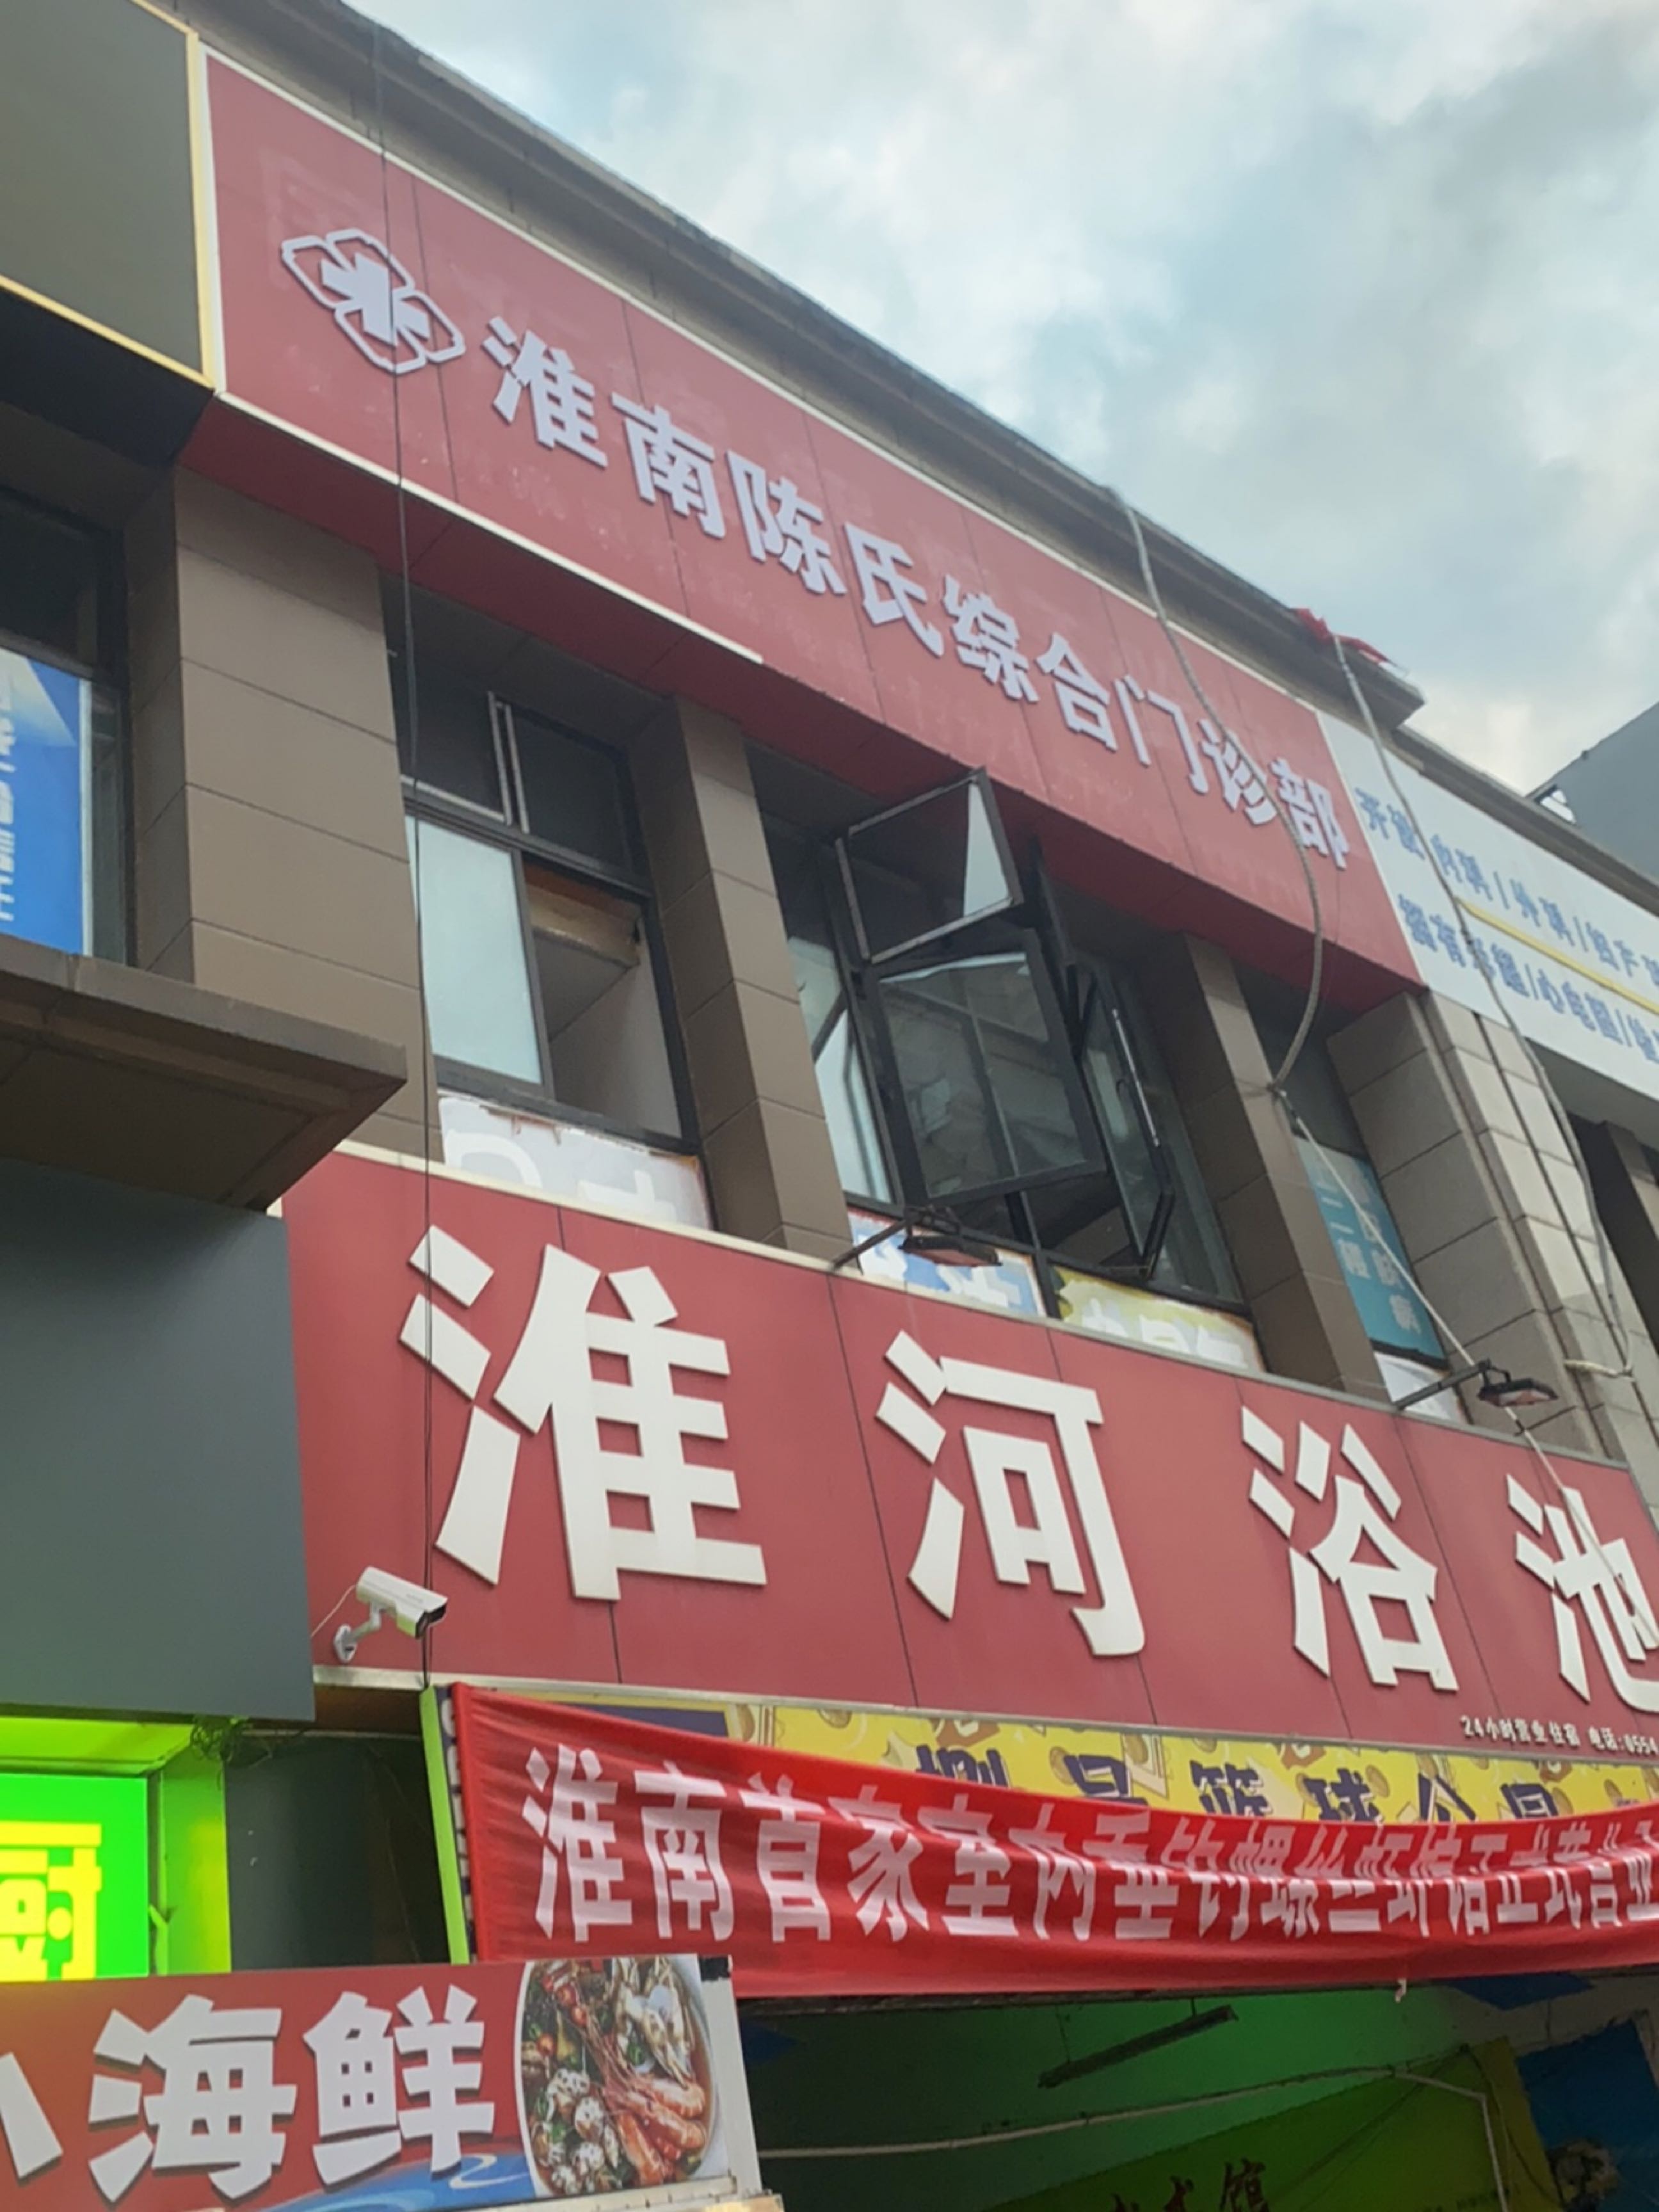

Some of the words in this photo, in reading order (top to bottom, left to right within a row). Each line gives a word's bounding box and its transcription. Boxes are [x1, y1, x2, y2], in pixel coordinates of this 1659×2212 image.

[482, 316, 1350, 870] 淮南陈氏综合门诊部
[399, 1224, 1659, 1713] 淮河浴池
